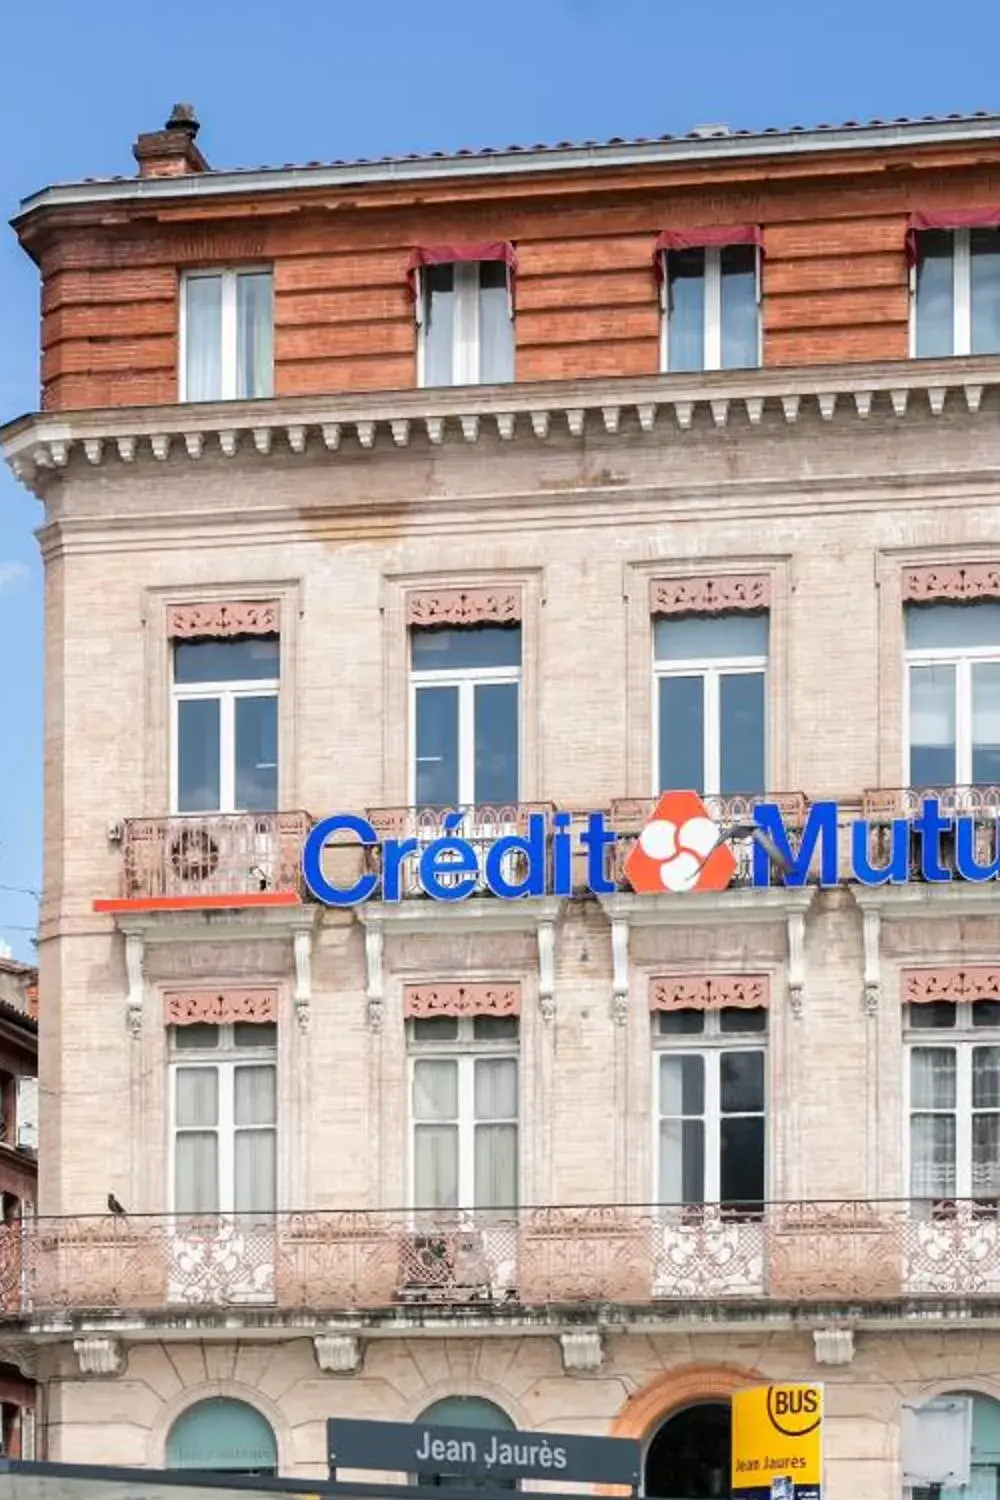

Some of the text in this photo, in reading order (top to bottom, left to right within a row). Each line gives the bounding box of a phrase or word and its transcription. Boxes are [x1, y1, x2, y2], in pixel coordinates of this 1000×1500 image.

[303, 812, 615, 905] Crédit
[775, 1389, 818, 1415] BUS
[416, 1431, 568, 1469] Jean Jaurès
[736, 1457, 760, 1473] Jean
